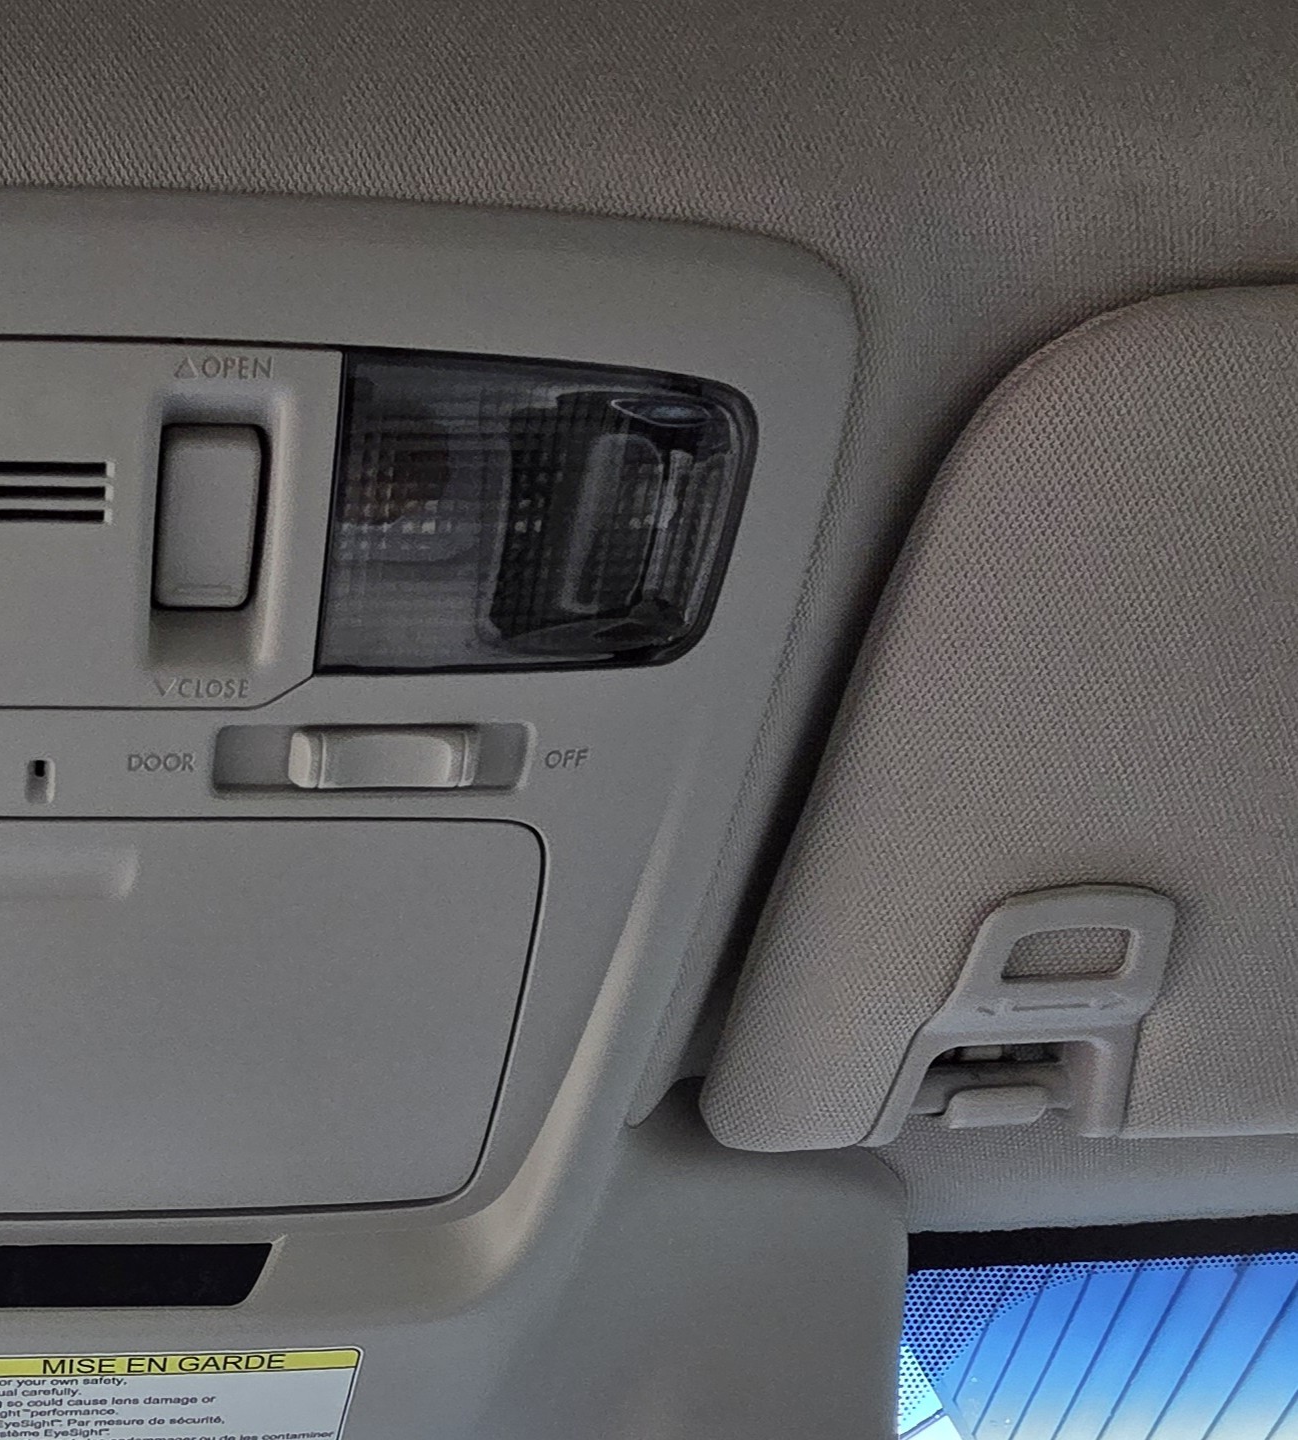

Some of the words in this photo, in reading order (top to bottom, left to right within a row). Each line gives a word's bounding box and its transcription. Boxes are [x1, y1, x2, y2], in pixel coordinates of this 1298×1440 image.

[202, 356, 273, 379] OPEN
[178, 679, 249, 698] CLOSE
[127, 753, 194, 772] DOOR
[545, 749, 589, 769] OFF
[42, 1358, 116, 1375] MISE
[126, 1357, 167, 1373] EN
[178, 1354, 287, 1371] GARDE
[17, 1379, 46, 1388] your
[22, 1388, 81, 1397] carefully.
[27, 1398, 63, 1407] could
[67, 1399, 108, 1407] cause
[111, 1397, 139, 1405] lens
[143, 1396, 198, 1405] damage
[201, 1396, 216, 1404] or
[67, 1418, 91, 1427] Par
[95, 1418, 144, 1427] mesure
[148, 1417, 165, 1425] de
